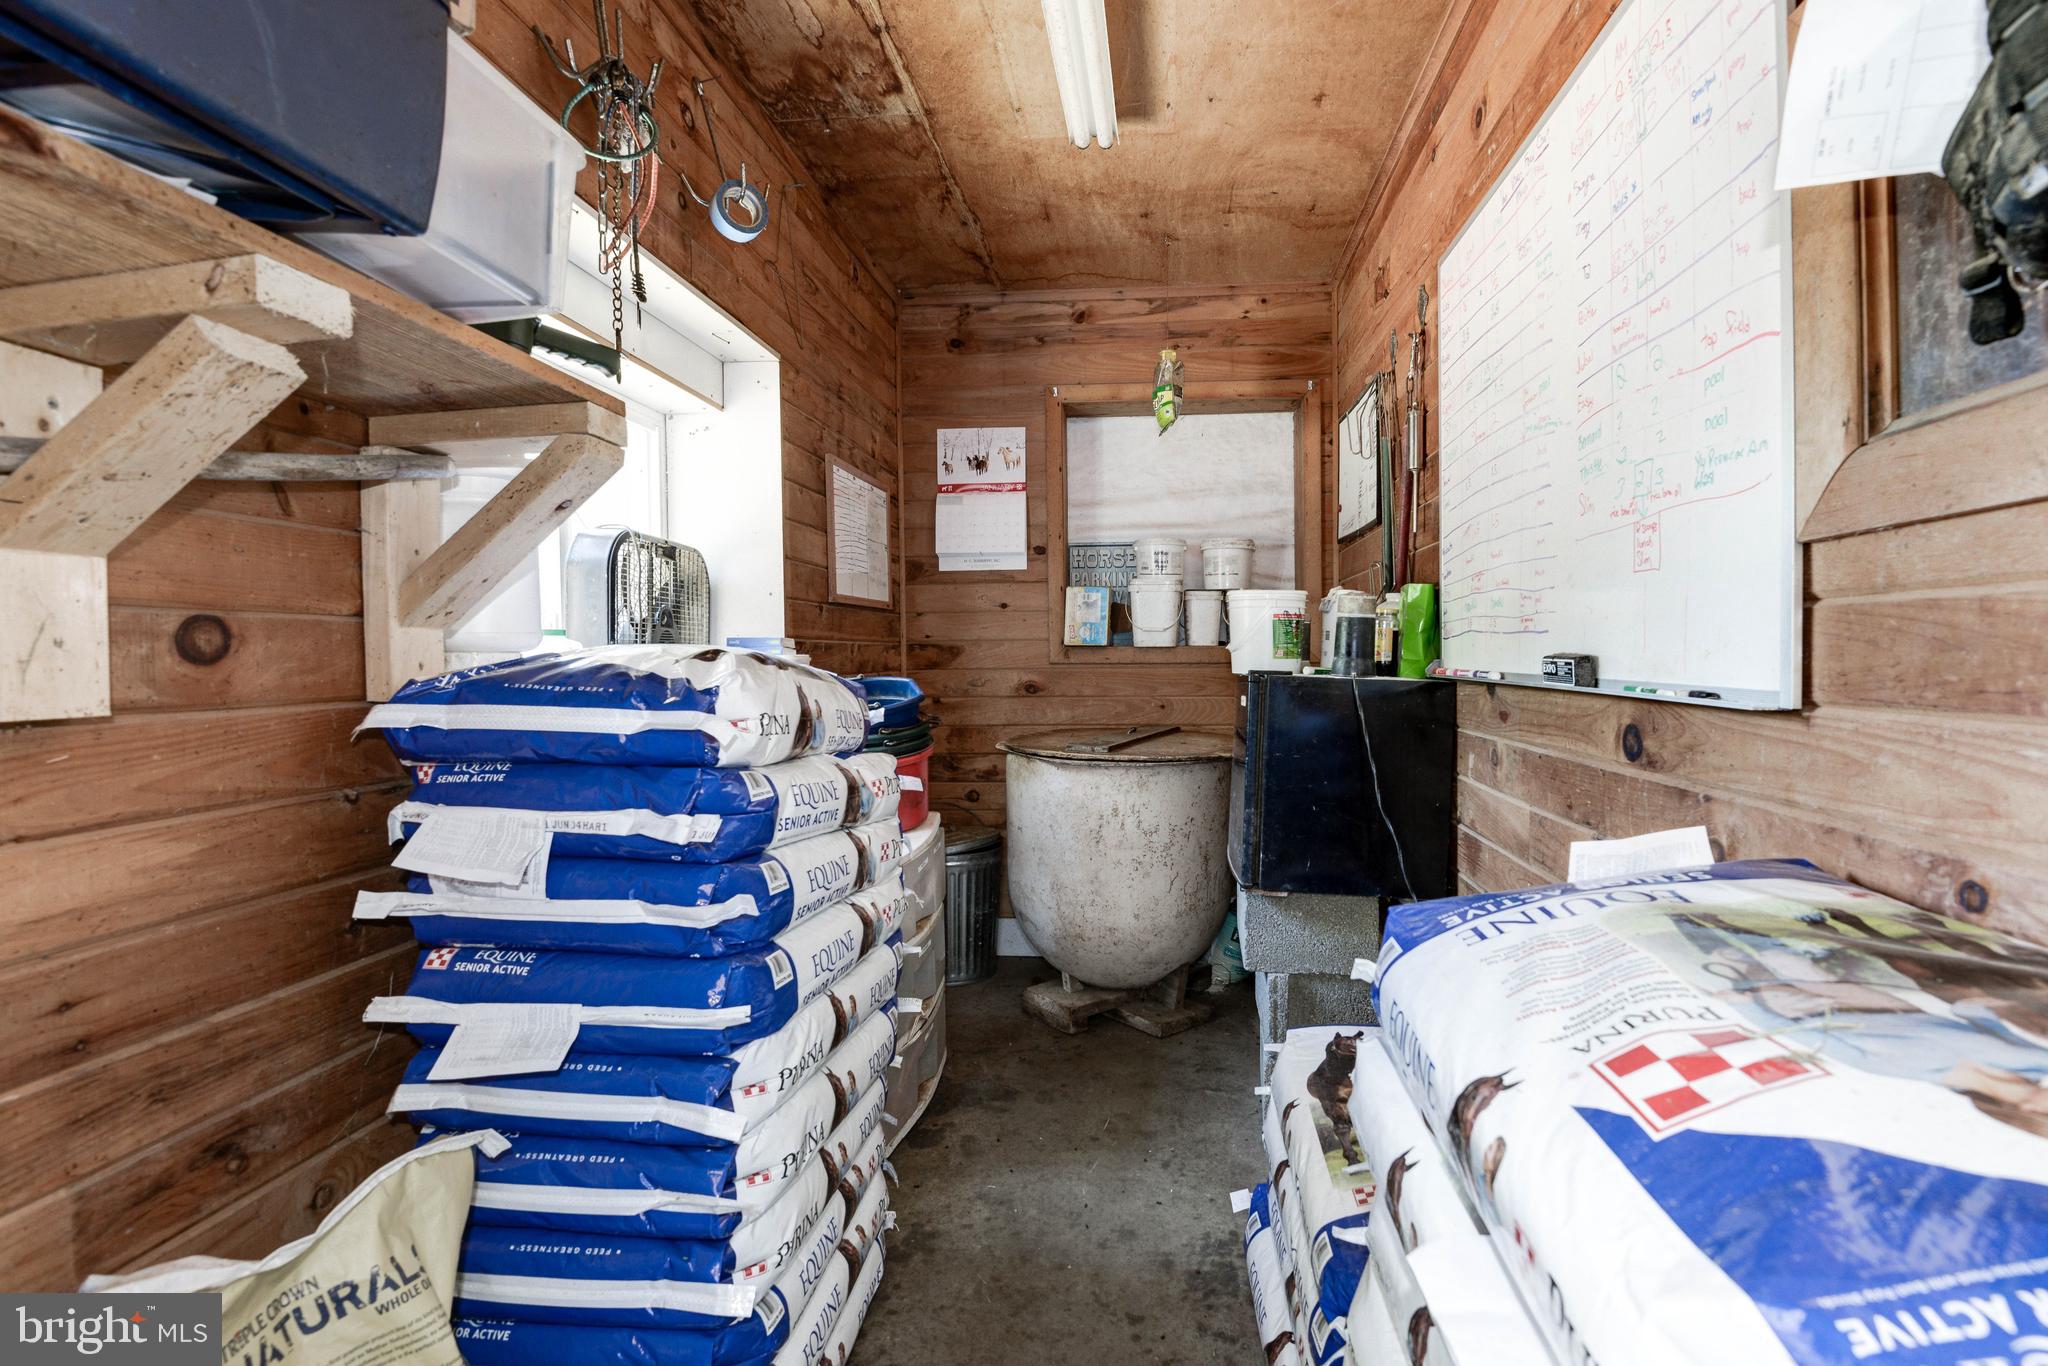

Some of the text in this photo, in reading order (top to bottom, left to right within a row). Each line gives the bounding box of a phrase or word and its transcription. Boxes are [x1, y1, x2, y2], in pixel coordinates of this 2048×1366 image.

[1072, 549, 1137, 569] HORSE
[436, 773, 506, 784] SENIOR ACTIVE
[792, 780, 840, 810] EQUINE
[777, 808, 840, 832] SENIOR ACTIVE
[807, 854, 850, 894] EQUINE
[1455, 889, 1693, 947] EQUINE
[454, 962, 530, 976] SENIOR ACTIVE
[474, 949, 537, 964] EQUINE
[811, 930, 855, 979] EQUINE
[870, 966, 896, 1008] EQUINE
[1572, 1004, 1724, 1055] PURINA
[587, 1064, 613, 1072] FEED
[868, 1034, 893, 1081] EQUINE
[1389, 998, 1437, 1111] EQUINE
[590, 1156, 617, 1164] FEED
[585, 1247, 612, 1255] FEED
[799, 1216, 839, 1296] EQUINE
[375, 1283, 422, 1316] WHOLE
[1250, 1259, 1268, 1327] EQUINE
[472, 1329, 511, 1341] ACTIVE
[802, 1283, 842, 1366] EQUINE
[1834, 1293, 2018, 1360] ACTIVE
